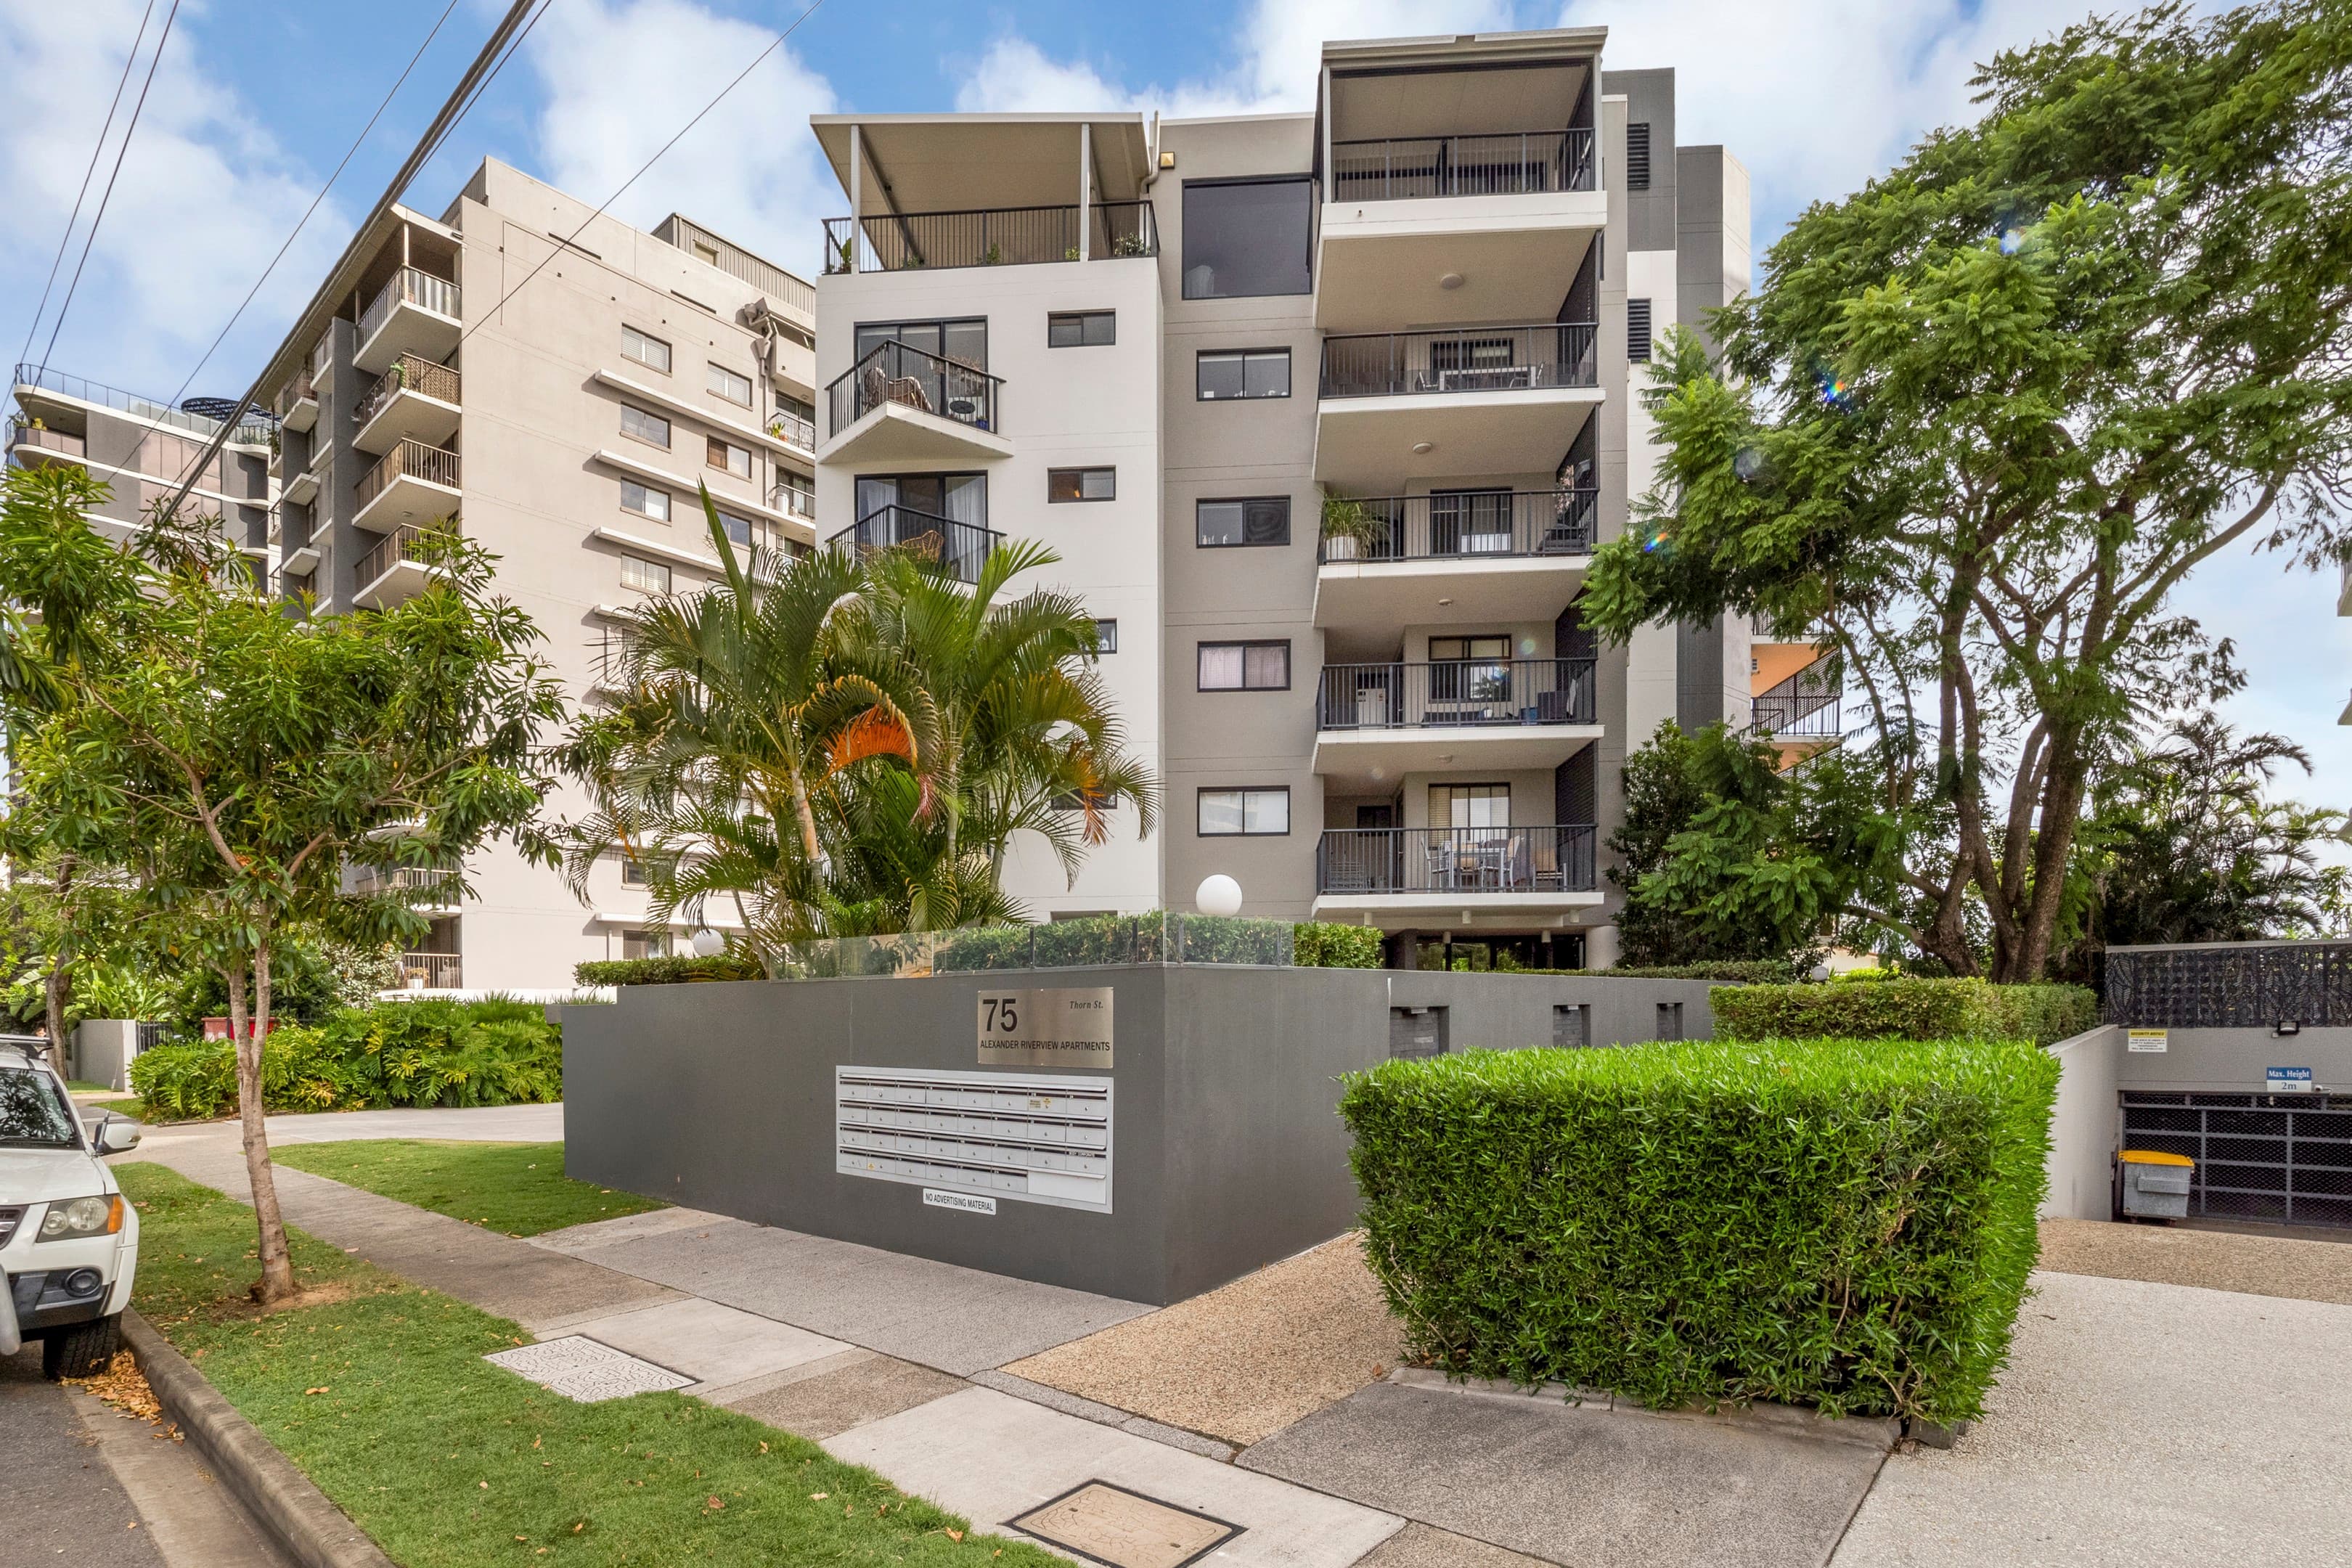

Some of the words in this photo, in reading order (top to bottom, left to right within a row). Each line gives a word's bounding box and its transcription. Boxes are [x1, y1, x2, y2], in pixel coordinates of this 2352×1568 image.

[1070, 1000, 1091, 1010] Thorn
[1093, 1000, 1103, 1009] St.
[982, 998, 1018, 1032] 75
[980, 1040, 1019, 1050] ALEXANDER
[1021, 1040, 1059, 1050] RIVERVIEW
[1060, 1041, 1111, 1051] APARTMENTS
[2287, 1069, 2309, 1079] Height
[2282, 1082, 2297, 1090] 2m
[925, 1193, 933, 1201] NO
[934, 1194, 966, 1207] ADVERTISING
[968, 1199, 993, 1212] MATERIAL
